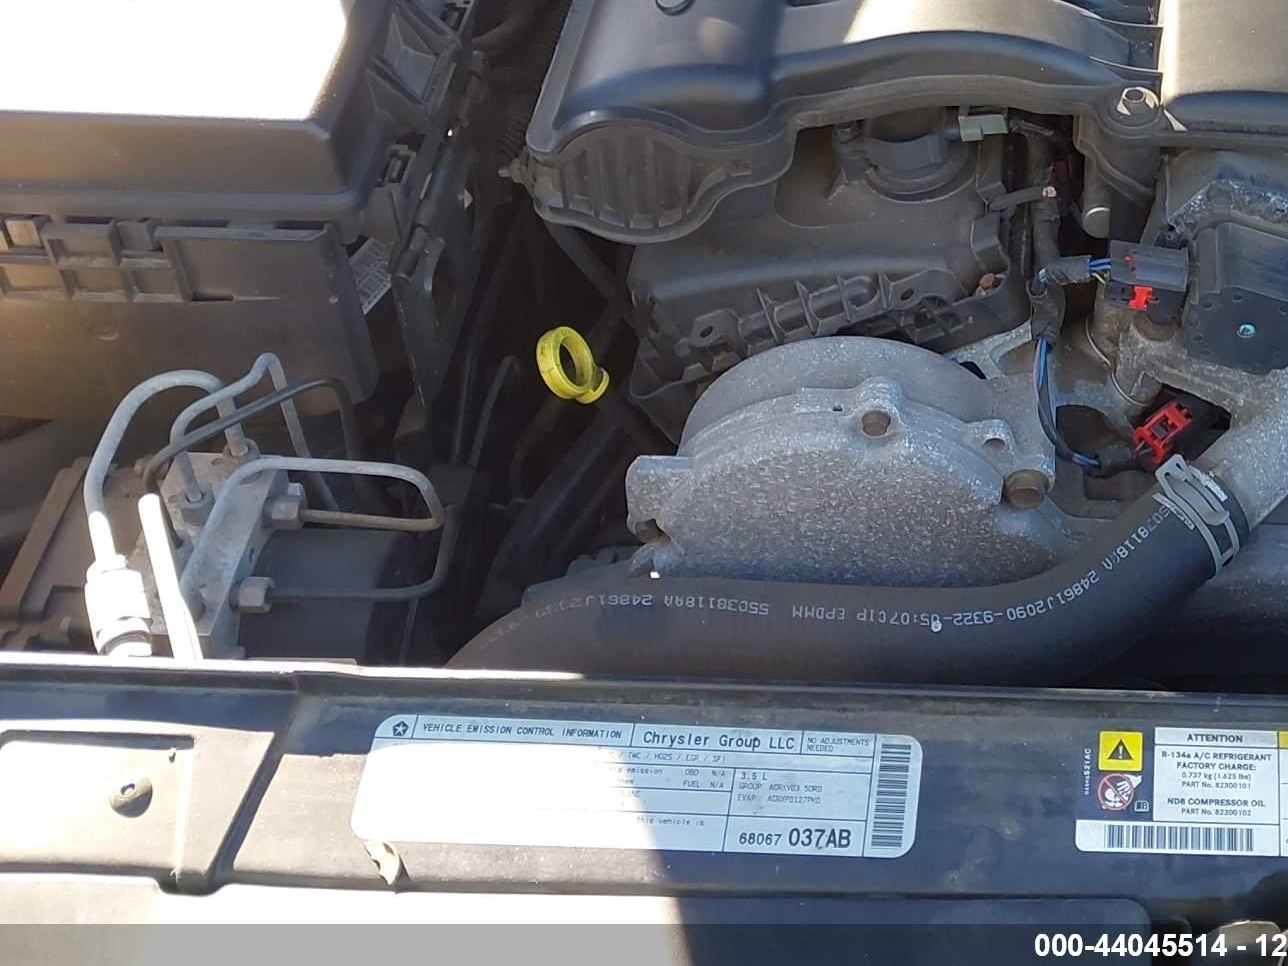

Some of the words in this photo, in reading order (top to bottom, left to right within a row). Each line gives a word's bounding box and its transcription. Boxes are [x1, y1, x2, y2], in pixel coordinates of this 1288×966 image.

[421, 722, 462, 733] VEHICLE
[465, 724, 513, 735] EMISSION
[515, 726, 555, 737] CONTROL
[561, 728, 622, 740] INFORMATION
[641, 730, 710, 748] Chrysler
[717, 734, 761, 751] Group
[768, 736, 796, 750] LLC
[806, 736, 817, 744] NO
[819, 737, 870, 746] ADJUSTMENTS
[1186, 732, 1243, 743] ATTENTION
[805, 744, 834, 752] NEEDED
[626, 751, 641, 760] TWC
[1161, 750, 1191, 758] R-134a
[1193, 751, 1210, 761] A/C
[1212, 752, 1272, 761] REFRIGERANT
[1176, 761, 1216, 770] FACTORY
[1217, 762, 1256, 771] CHARGE:
[710, 769, 726, 777] N/A
[739, 771, 758, 780] 3.5
[761, 772, 769, 781] L
[1203, 771, 1212, 780] kg
[1213, 772, 1236, 781] (1.625
[1238, 773, 1251, 782] lbs)
[681, 779, 701, 788] FUEL
[708, 780, 725, 789] N/A
[737, 782, 762, 791] GROUP
[1181, 780, 1200, 788] PART
[1187, 797, 1248, 807] COMPRESSOR
[1250, 799, 1266, 807] OIL
[1181, 807, 1200, 815] PART
[657, 816, 691, 826] vehicle
[694, 818, 705, 826] is
[737, 832, 782, 846] 68067
[786, 826, 853, 849] 037AB
